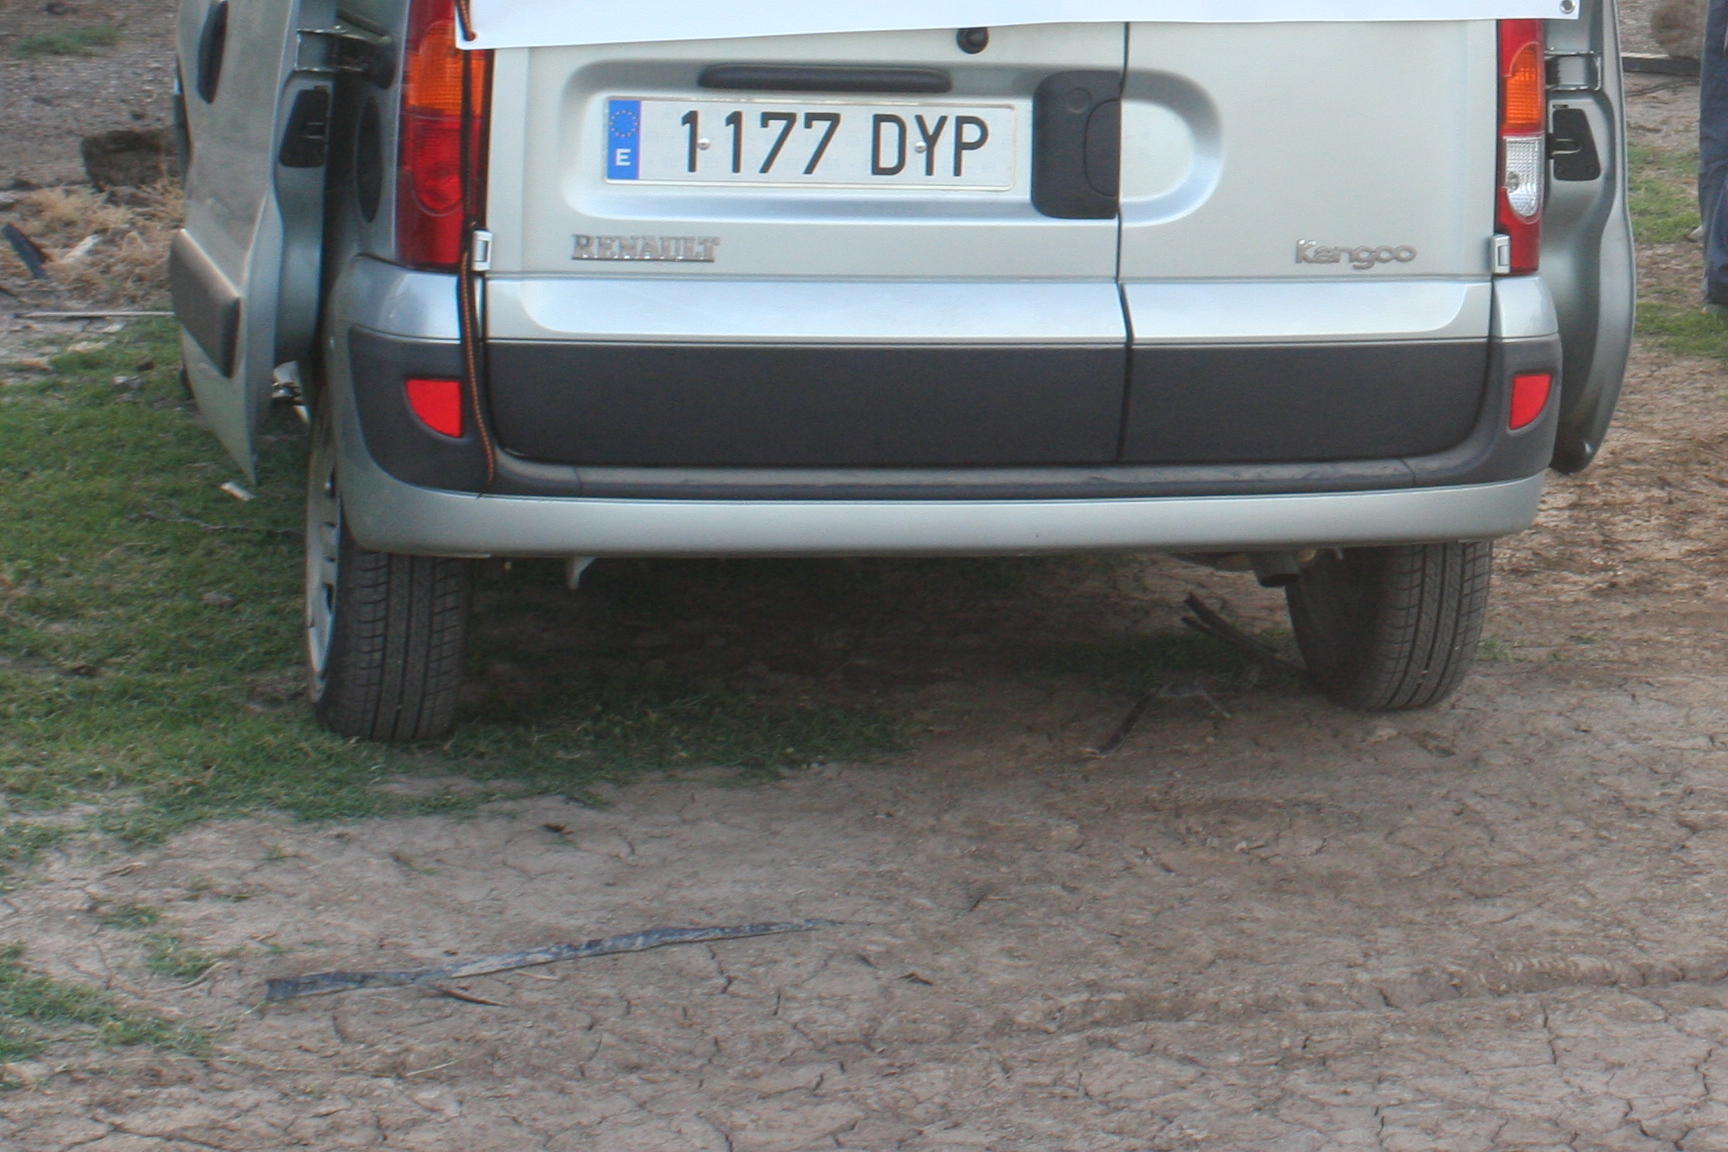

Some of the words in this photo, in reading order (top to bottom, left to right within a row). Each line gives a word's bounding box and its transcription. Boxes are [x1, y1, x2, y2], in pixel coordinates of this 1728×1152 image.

[615, 148, 631, 166] E
[681, 110, 842, 175] 1177
[871, 113, 989, 177] DYP
[571, 233, 720, 262] RENAULT
